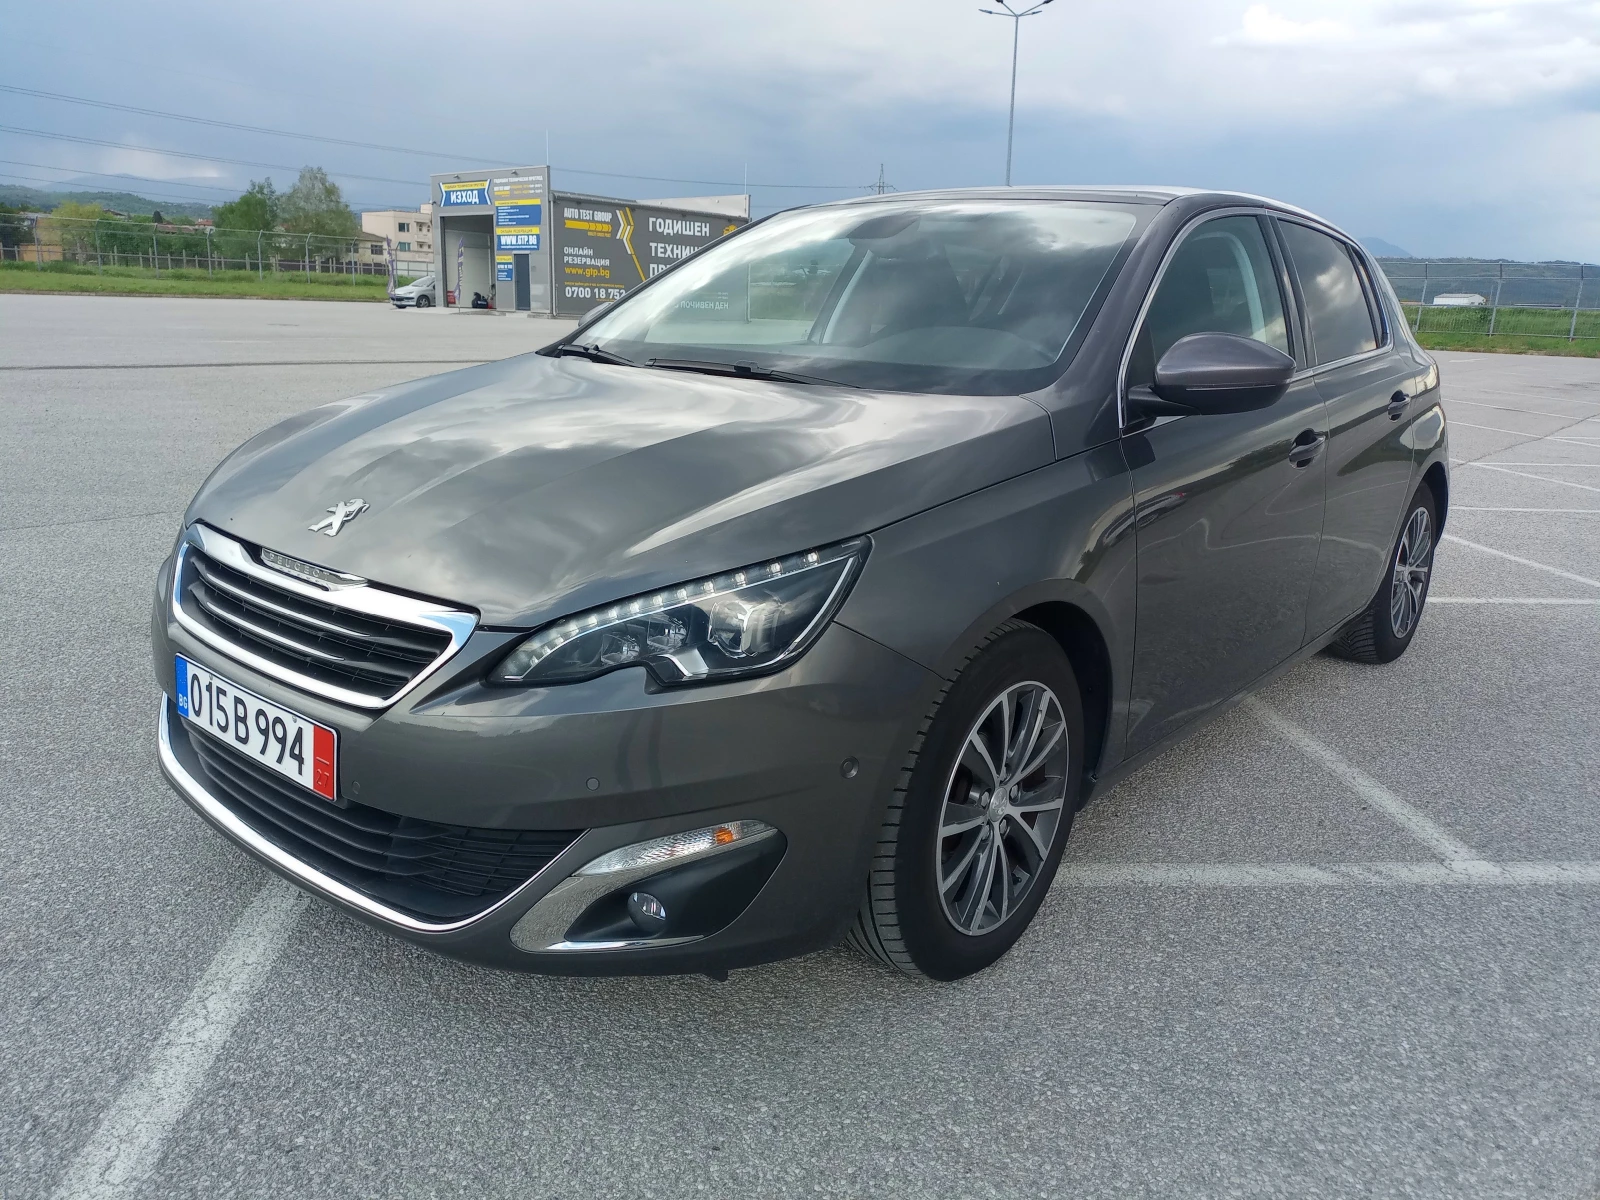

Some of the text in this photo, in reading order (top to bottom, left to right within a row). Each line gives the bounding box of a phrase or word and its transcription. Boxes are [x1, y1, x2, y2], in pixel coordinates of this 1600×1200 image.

[450, 190, 479, 204] ИЗХОД
[564, 207, 612, 222] AUTO TEST GROUP
[648, 217, 710, 237] ГОДИШЕН
[564, 246, 593, 256] ОНЛАЙН
[564, 256, 610, 267] РЕЗЕРВАЦИЯ
[564, 267, 610, 278] www.gtp.bg
[565, 286, 591, 298] 0700
[594, 288, 606, 299] 18
[680, 300, 714, 309] ПОЧИВЕН
[714, 301, 729, 310] ДЕН
[268, 552, 330, 581] PEUGEOT
[178, 693, 189, 710] BG
